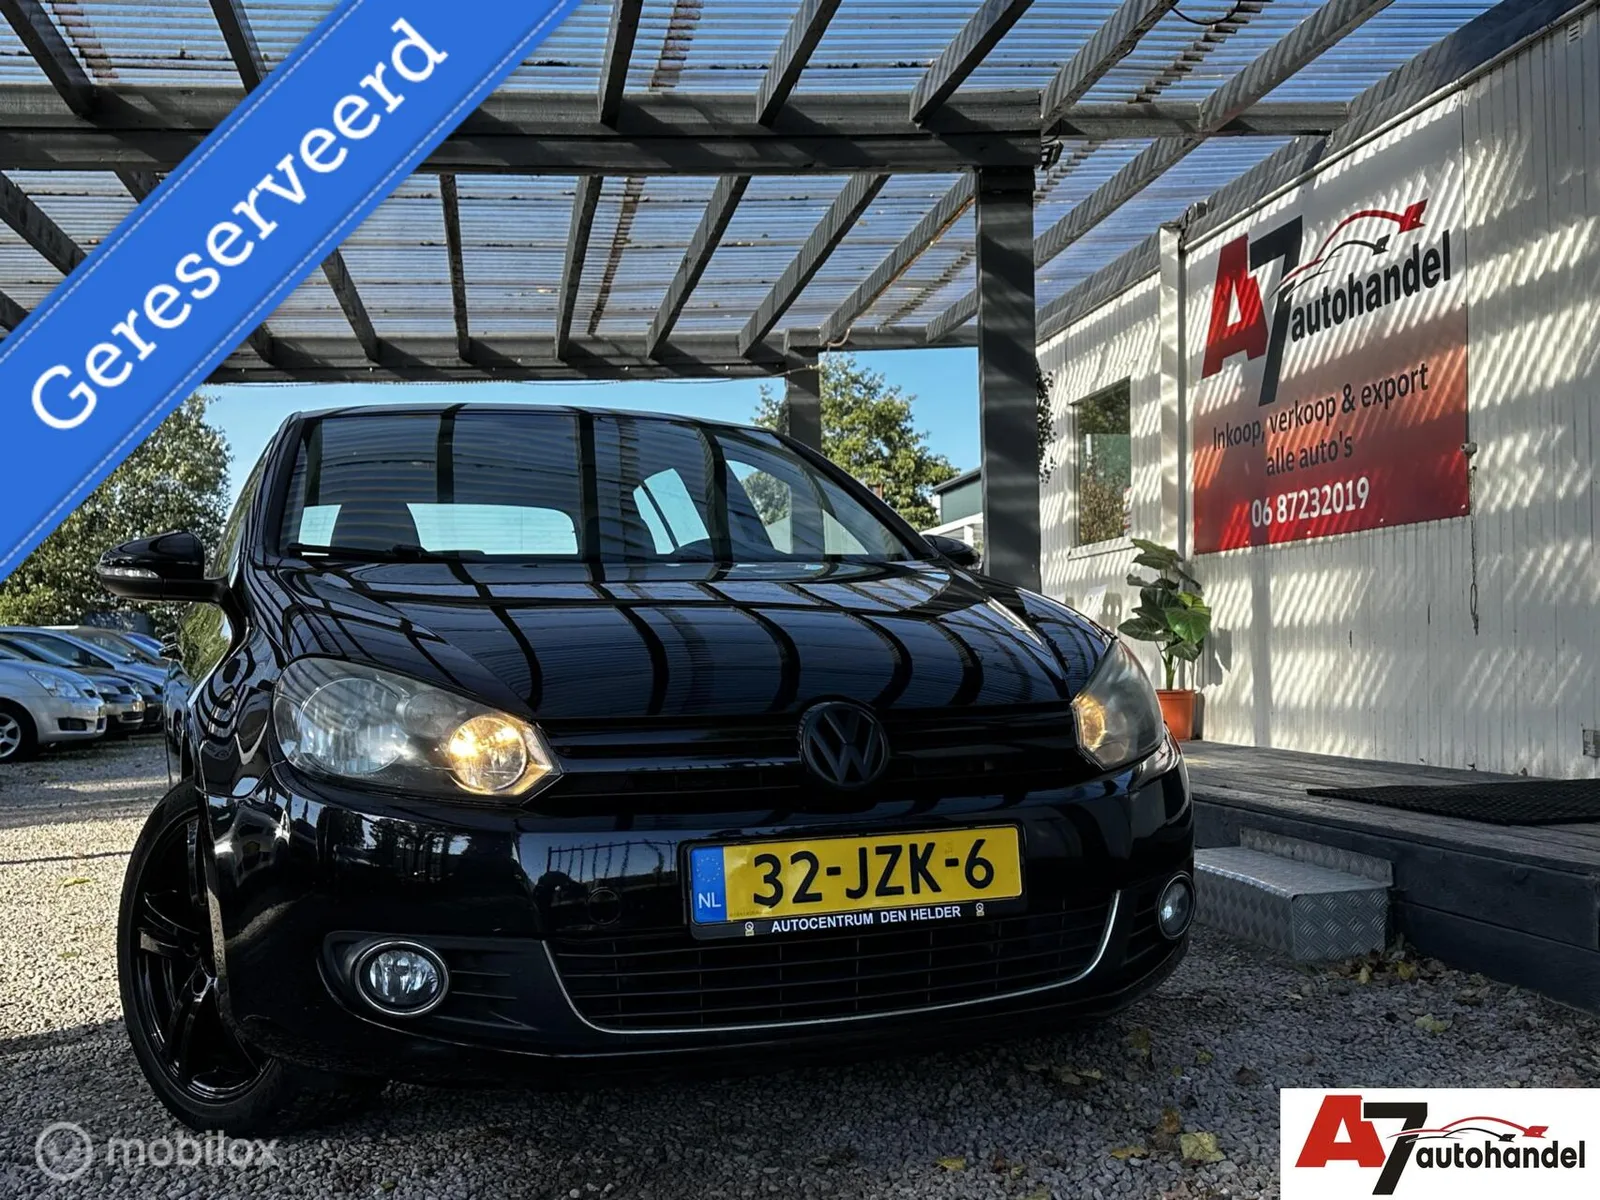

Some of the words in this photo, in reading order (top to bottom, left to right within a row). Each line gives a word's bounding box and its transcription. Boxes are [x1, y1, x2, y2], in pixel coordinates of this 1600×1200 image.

[1291, 229, 1451, 342] autohandel
[1213, 420, 1265, 450] Inkoop,
[1269, 395, 1336, 434] verkoop
[1341, 383, 1356, 414] &
[1361, 363, 1429, 409] export
[1267, 448, 1295, 476] alle
[1299, 431, 1353, 469] auto's
[1251, 497, 1273, 527] 06
[1276, 476, 1370, 523] 87232019
[753, 839, 995, 909] 32-JZK-6
[698, 892, 721, 909] NL
[771, 912, 874, 934] AUTOCENTRUM
[880, 910, 907, 924] DEN
[910, 905, 962, 921] HELDER
